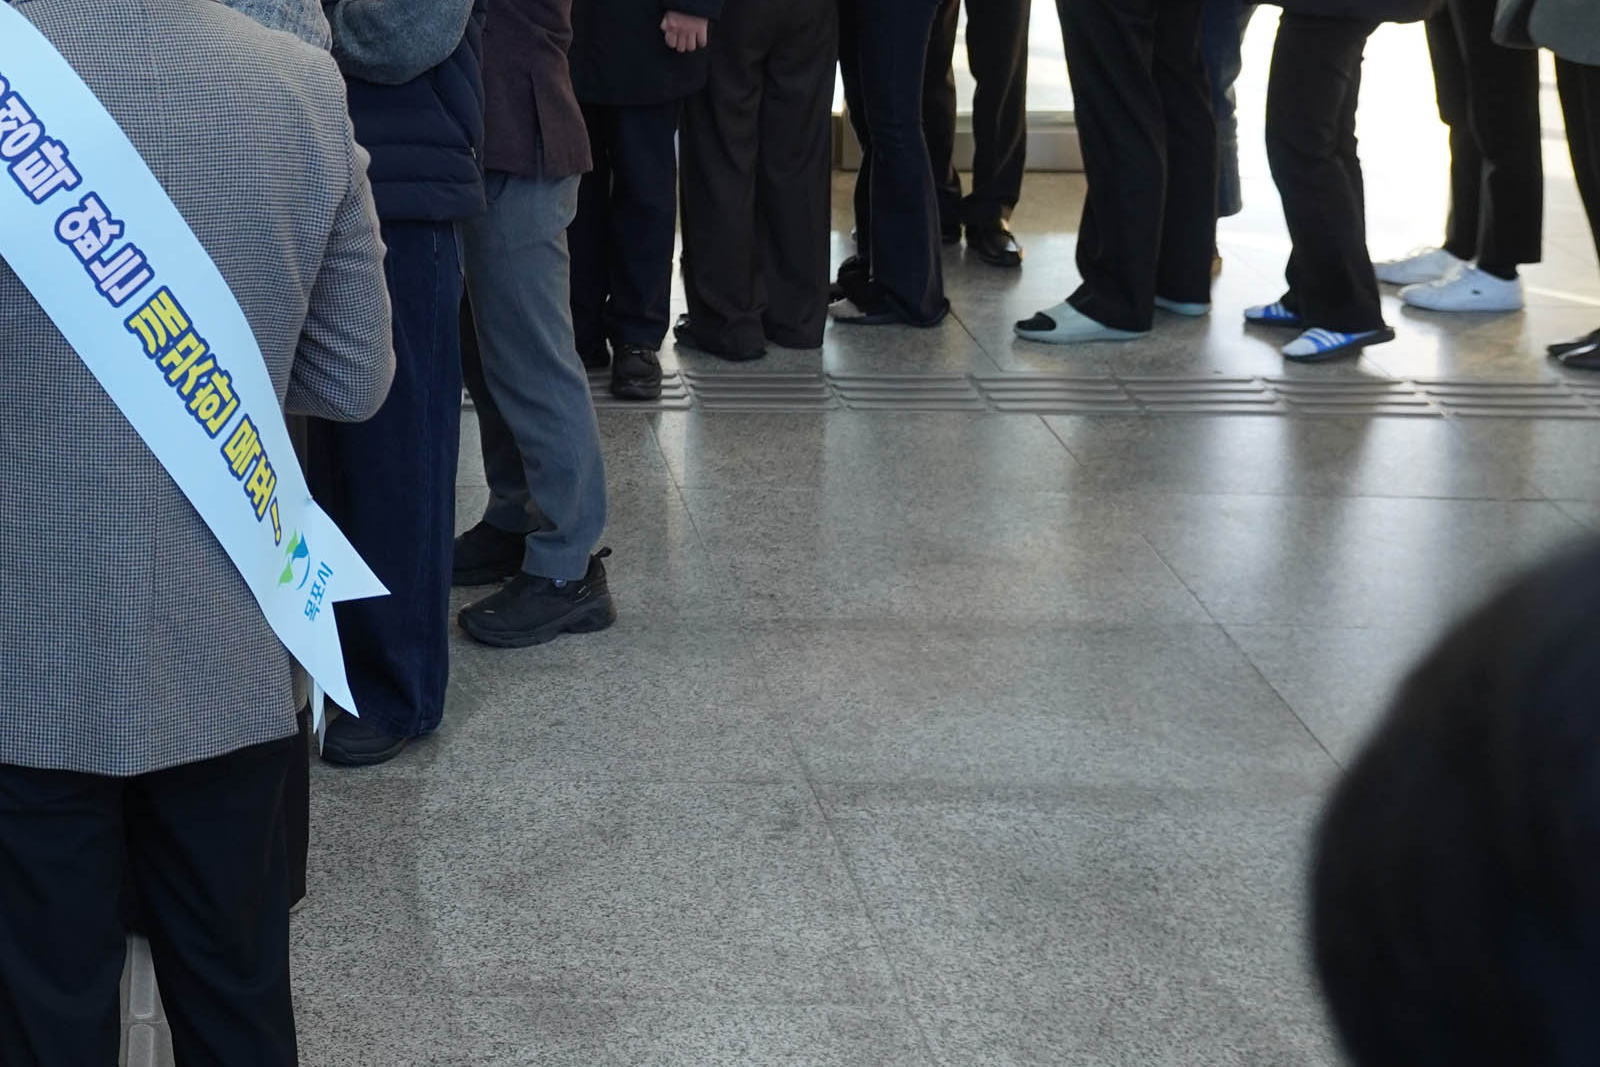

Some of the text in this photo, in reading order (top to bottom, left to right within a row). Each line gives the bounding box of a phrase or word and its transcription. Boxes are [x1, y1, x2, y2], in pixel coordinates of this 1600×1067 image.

[54, 192, 155, 307] 없는
[125, 287, 240, 439] 깨끗한
[222, 415, 285, 544] 목포!
[303, 559, 334, 624] 목포시
